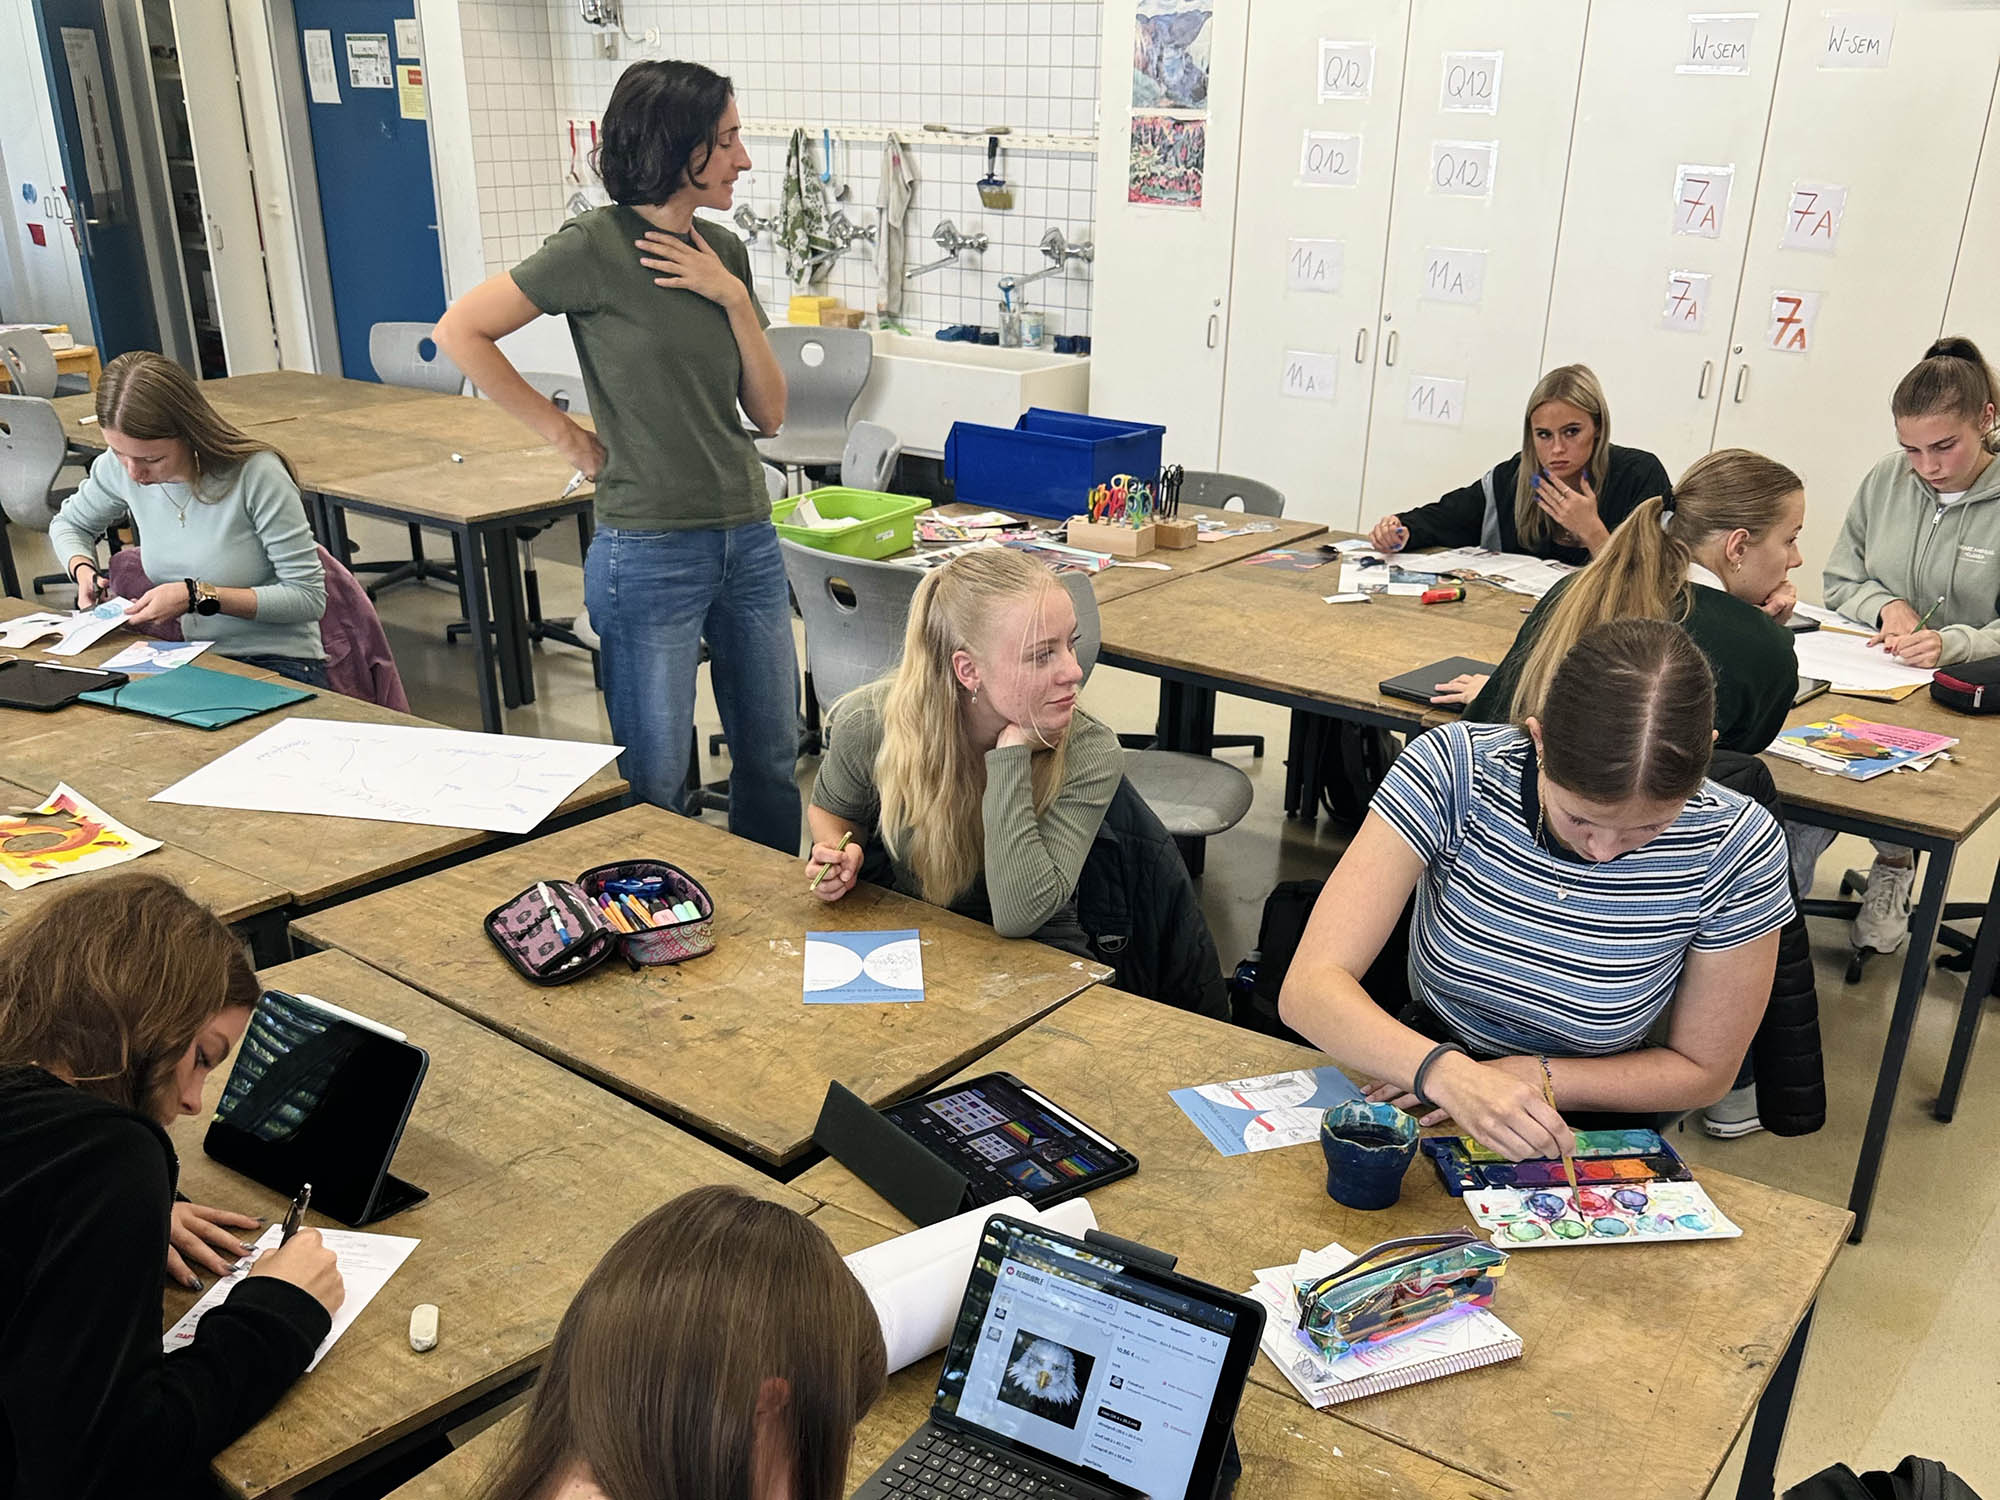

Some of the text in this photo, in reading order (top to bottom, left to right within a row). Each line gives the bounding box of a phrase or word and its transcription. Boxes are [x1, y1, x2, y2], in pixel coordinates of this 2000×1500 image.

[1691, 28, 1745, 60] W-SEM
[1828, 26, 1880, 55] W-SEM
[1325, 56, 1365, 89] Q12
[1447, 65, 1494, 98] Q12
[1307, 143, 1350, 176] Q12
[1436, 153, 1484, 188] Q12
[1683, 178, 1717, 231] 7A
[1794, 192, 1833, 239] 7A
[1291, 247, 1326, 281] 11A
[1428, 260, 1464, 294] 11A
[1672, 279, 1697, 321] 7A
[1775, 296, 1807, 350] 7A
[1286, 361, 1315, 393] 11A
[1411, 385, 1451, 419] 11A
